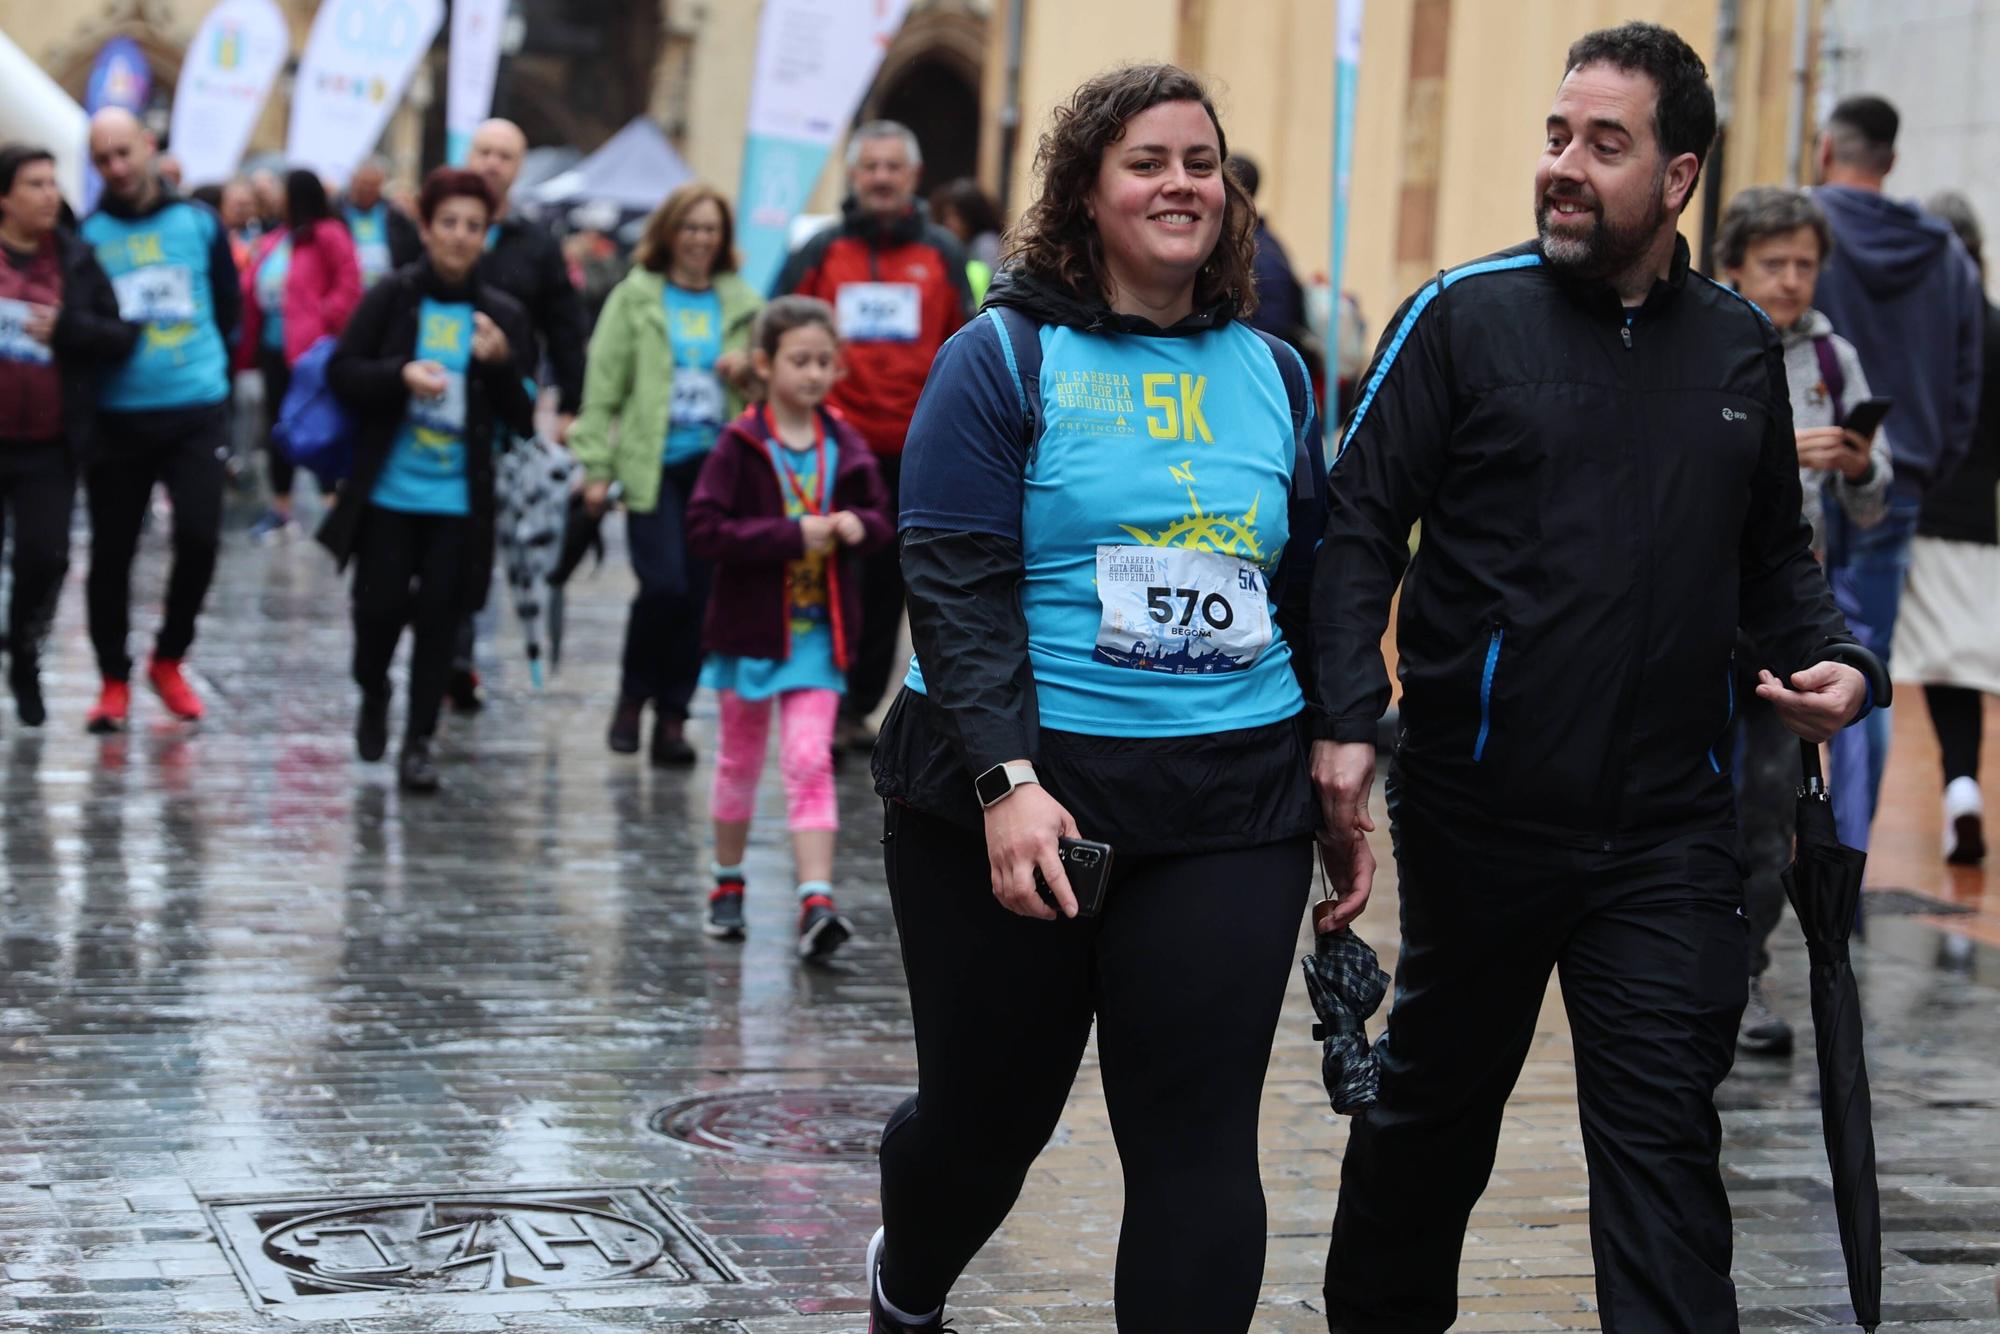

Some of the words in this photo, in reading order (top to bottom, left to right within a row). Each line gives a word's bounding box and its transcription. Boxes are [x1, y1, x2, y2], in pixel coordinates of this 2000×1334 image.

[1055, 370, 1067, 383] IV
[1073, 371, 1130, 386] CARRERA
[1056, 383, 1089, 396] RUTA
[1091, 384, 1112, 398] POR
[1115, 386, 1132, 399] LA
[1058, 395, 1134, 412] SEGURIDAD
[1142, 373, 1216, 444] 5K
[1168, 460, 1195, 485] N
[1108, 556, 1117, 564] IV
[1120, 556, 1155, 565] CARRERA
[1108, 564, 1128, 573] RUTA
[1130, 564, 1144, 573] POR
[1146, 564, 1155, 573] LA
[1108, 573, 1156, 583] SEGURIDAD
[1238, 568, 1259, 592] 5K
[1147, 587, 1234, 630] 570
[1172, 627, 1213, 639] BEGOÑA
